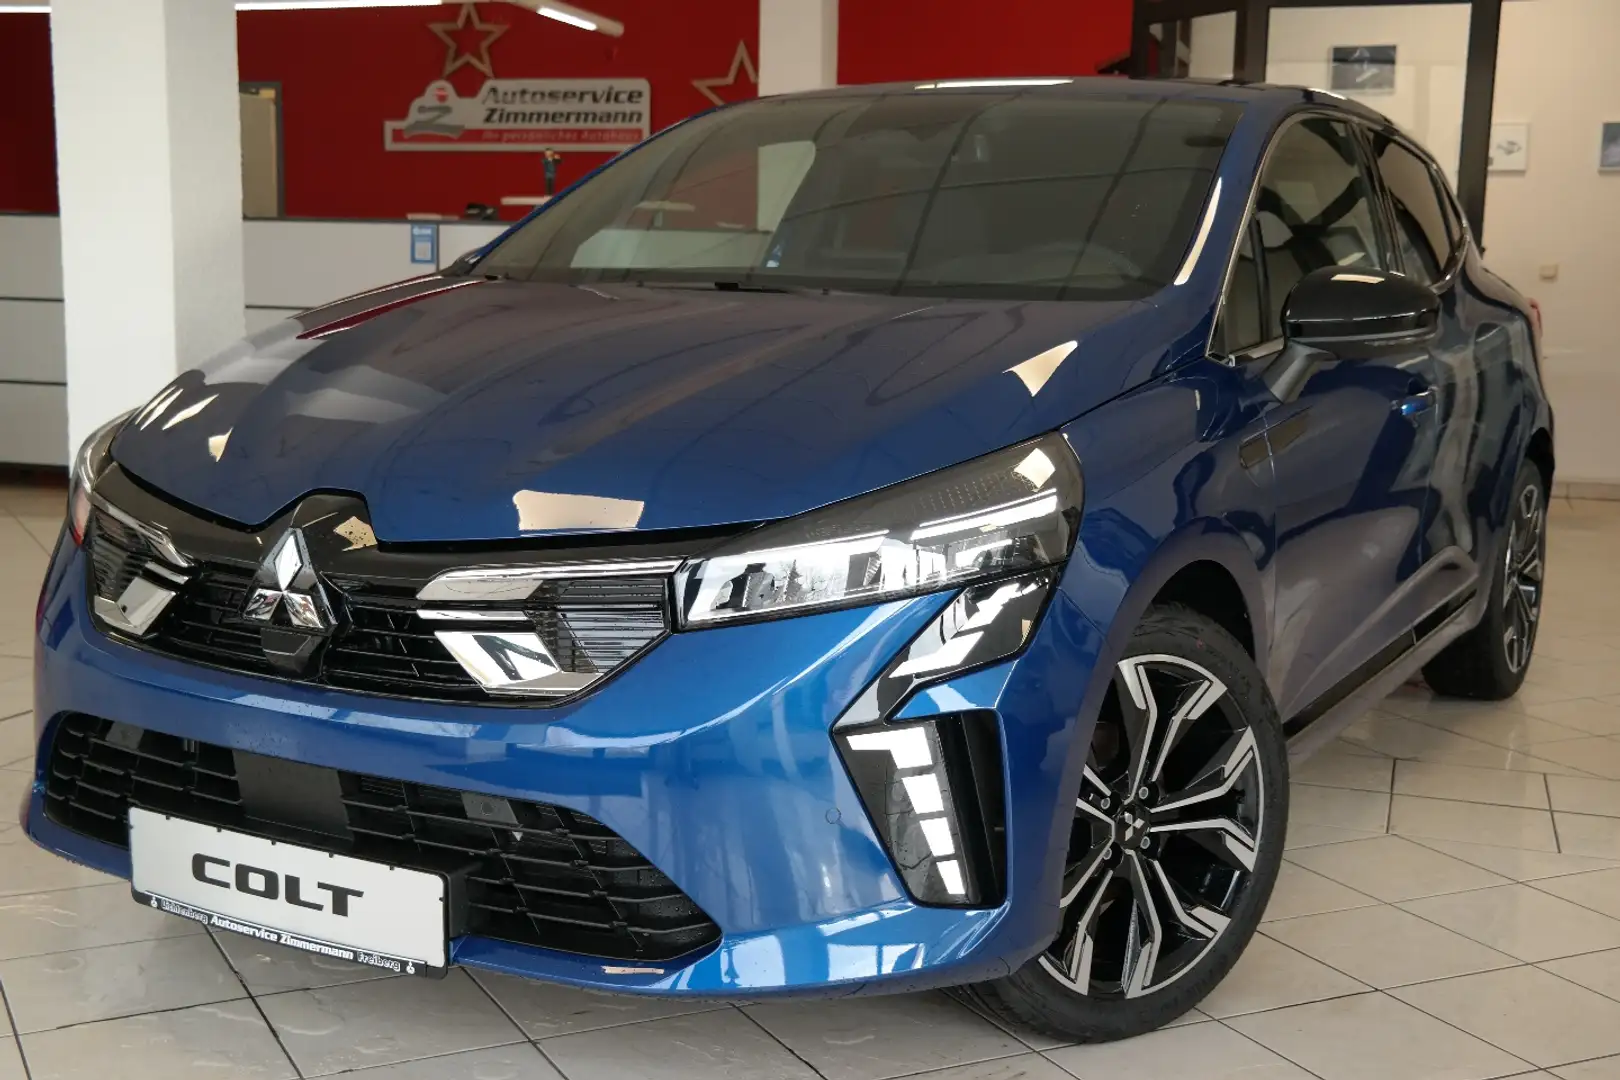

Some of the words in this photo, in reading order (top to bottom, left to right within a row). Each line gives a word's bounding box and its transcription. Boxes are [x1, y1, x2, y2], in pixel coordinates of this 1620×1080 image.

[482, 85, 644, 104] Autoservice
[483, 108, 643, 124] Zimmermann
[191, 852, 365, 918] COLT
[210, 914, 278, 942] Autoservice
[279, 932, 354, 960] Zimmermann
[357, 951, 401, 972] Freiberg
